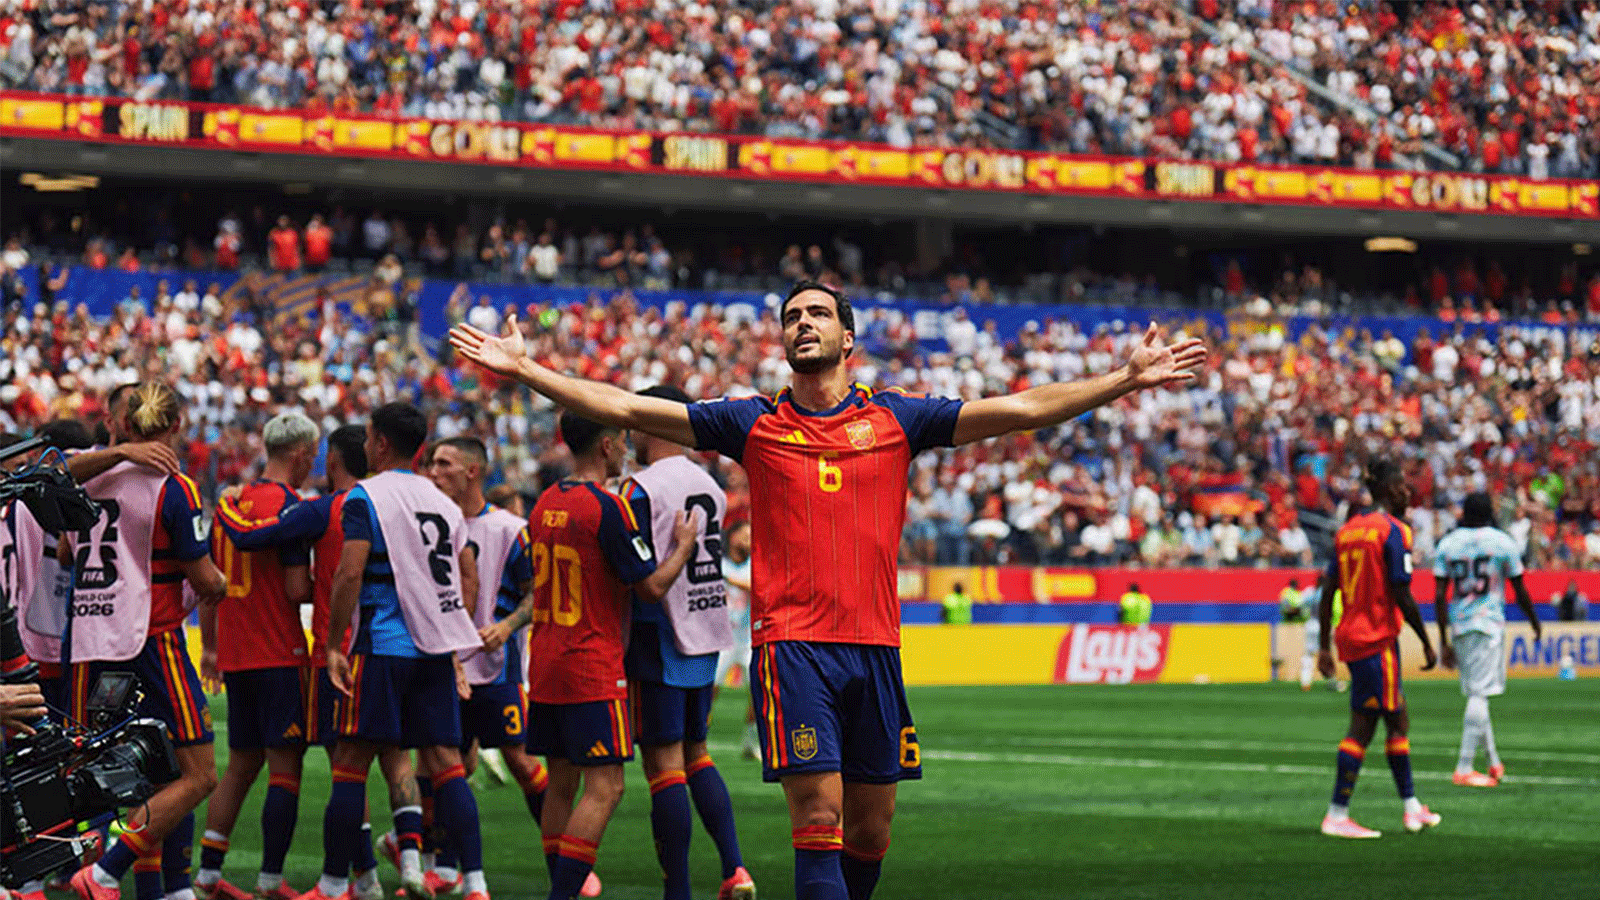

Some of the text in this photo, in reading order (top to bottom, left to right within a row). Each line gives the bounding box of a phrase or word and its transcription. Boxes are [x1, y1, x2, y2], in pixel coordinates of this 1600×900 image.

[119, 103, 189, 141] SPAIN
[818, 450, 842, 492] 6
[82, 570, 105, 582] FIFA
[532, 542, 582, 627] 20
[1340, 548, 1365, 604] 17
[1449, 554, 1491, 599] 25
[1066, 623, 1162, 684] Lay's
[503, 704, 523, 736] 3
[900, 723, 921, 768] 6
